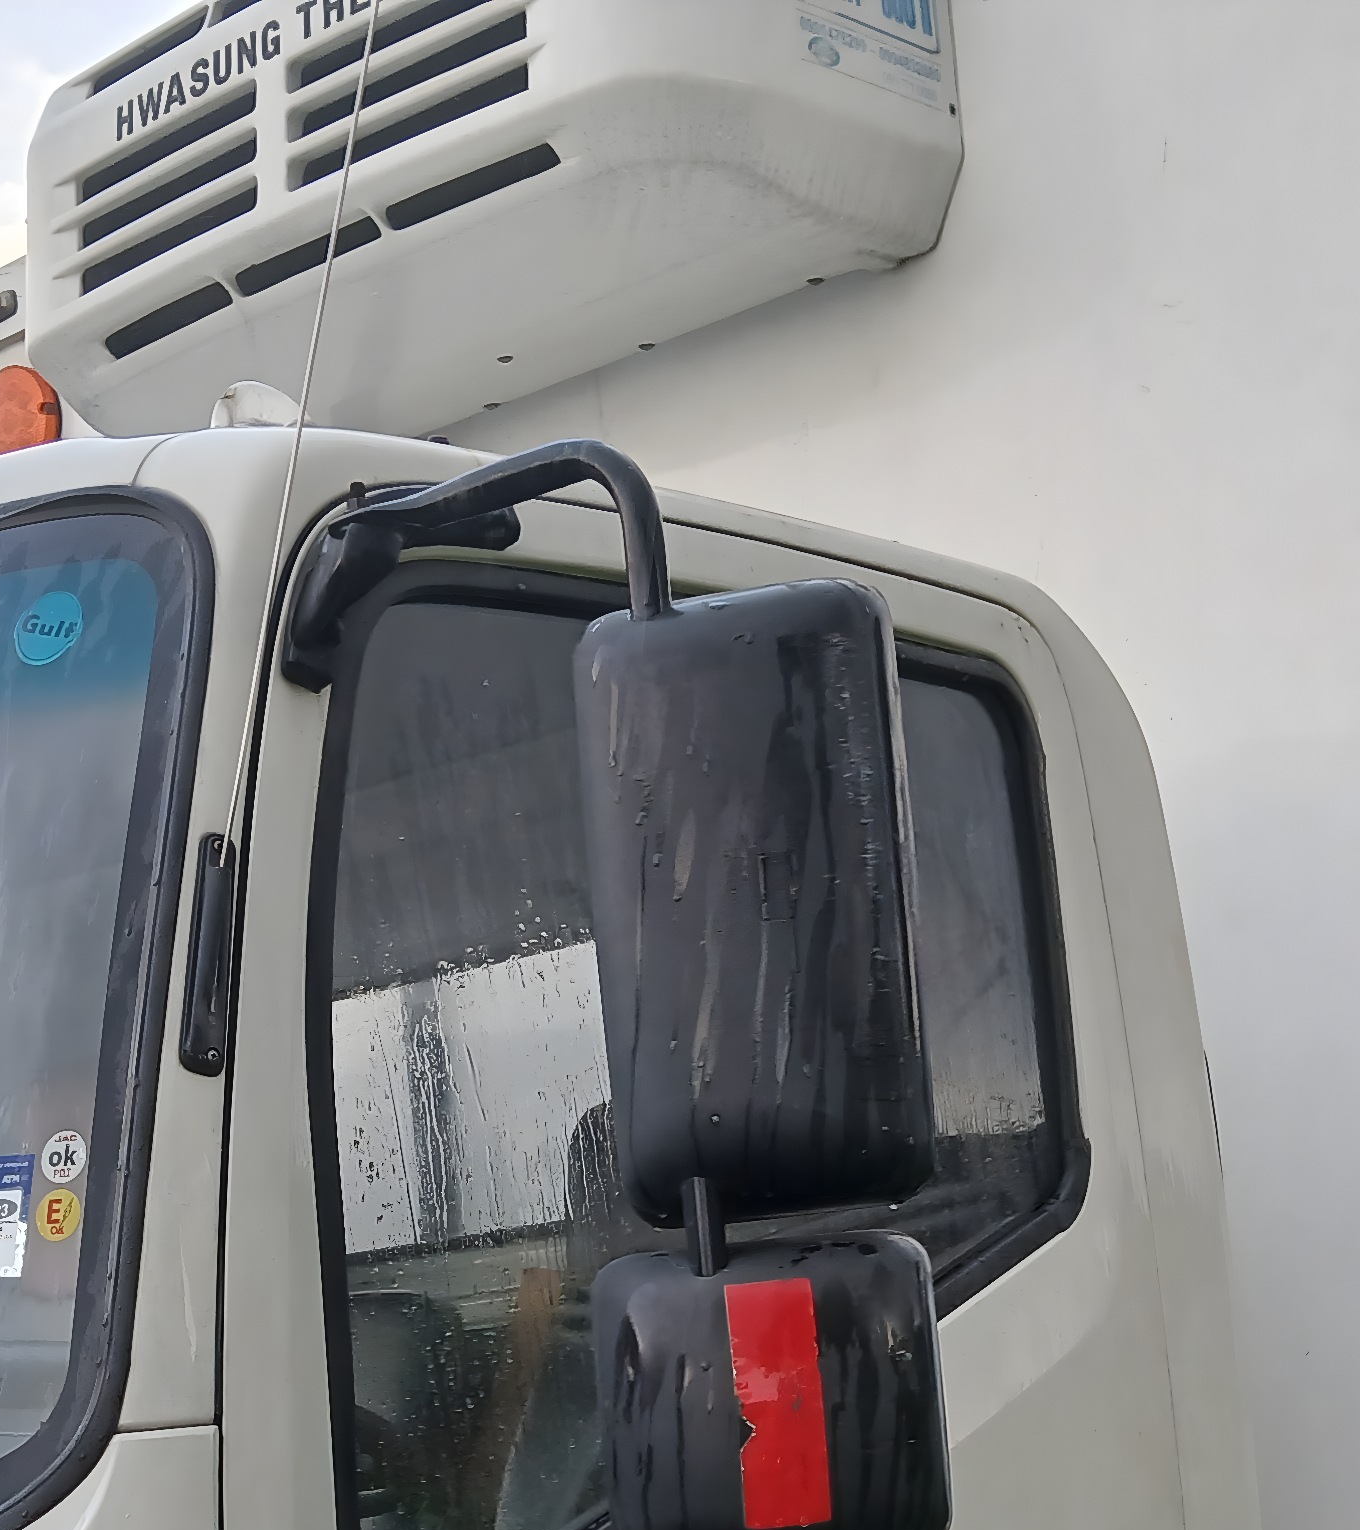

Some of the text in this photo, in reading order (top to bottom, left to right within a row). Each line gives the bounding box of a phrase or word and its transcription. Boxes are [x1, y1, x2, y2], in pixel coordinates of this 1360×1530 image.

[116, 20, 281, 141] HWASUNG
[22, 614, 78, 638] Gulf
[47, 1199, 62, 1224] E
